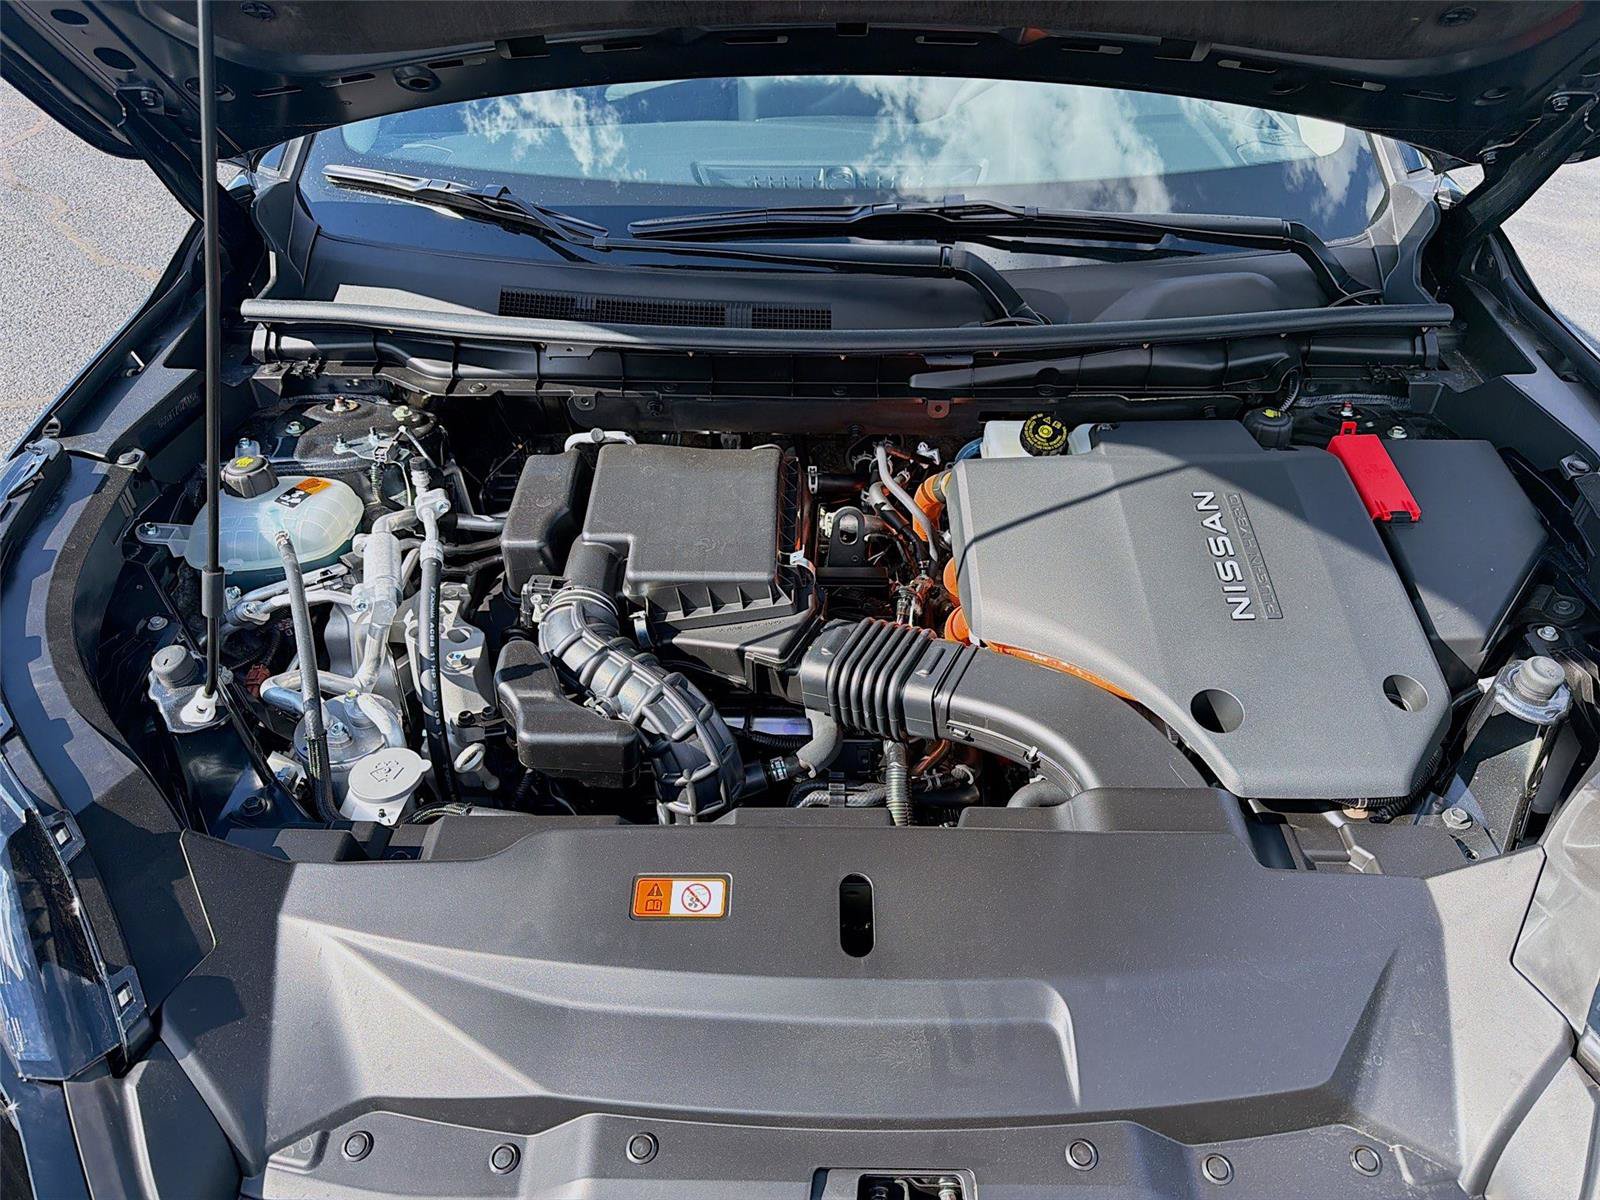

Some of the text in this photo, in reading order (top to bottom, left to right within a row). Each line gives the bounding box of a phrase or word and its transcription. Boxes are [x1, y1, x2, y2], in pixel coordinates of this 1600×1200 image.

[1192, 491, 1256, 620] NISSAN
[1228, 493, 1280, 615] PLUG-IN HYBRID
